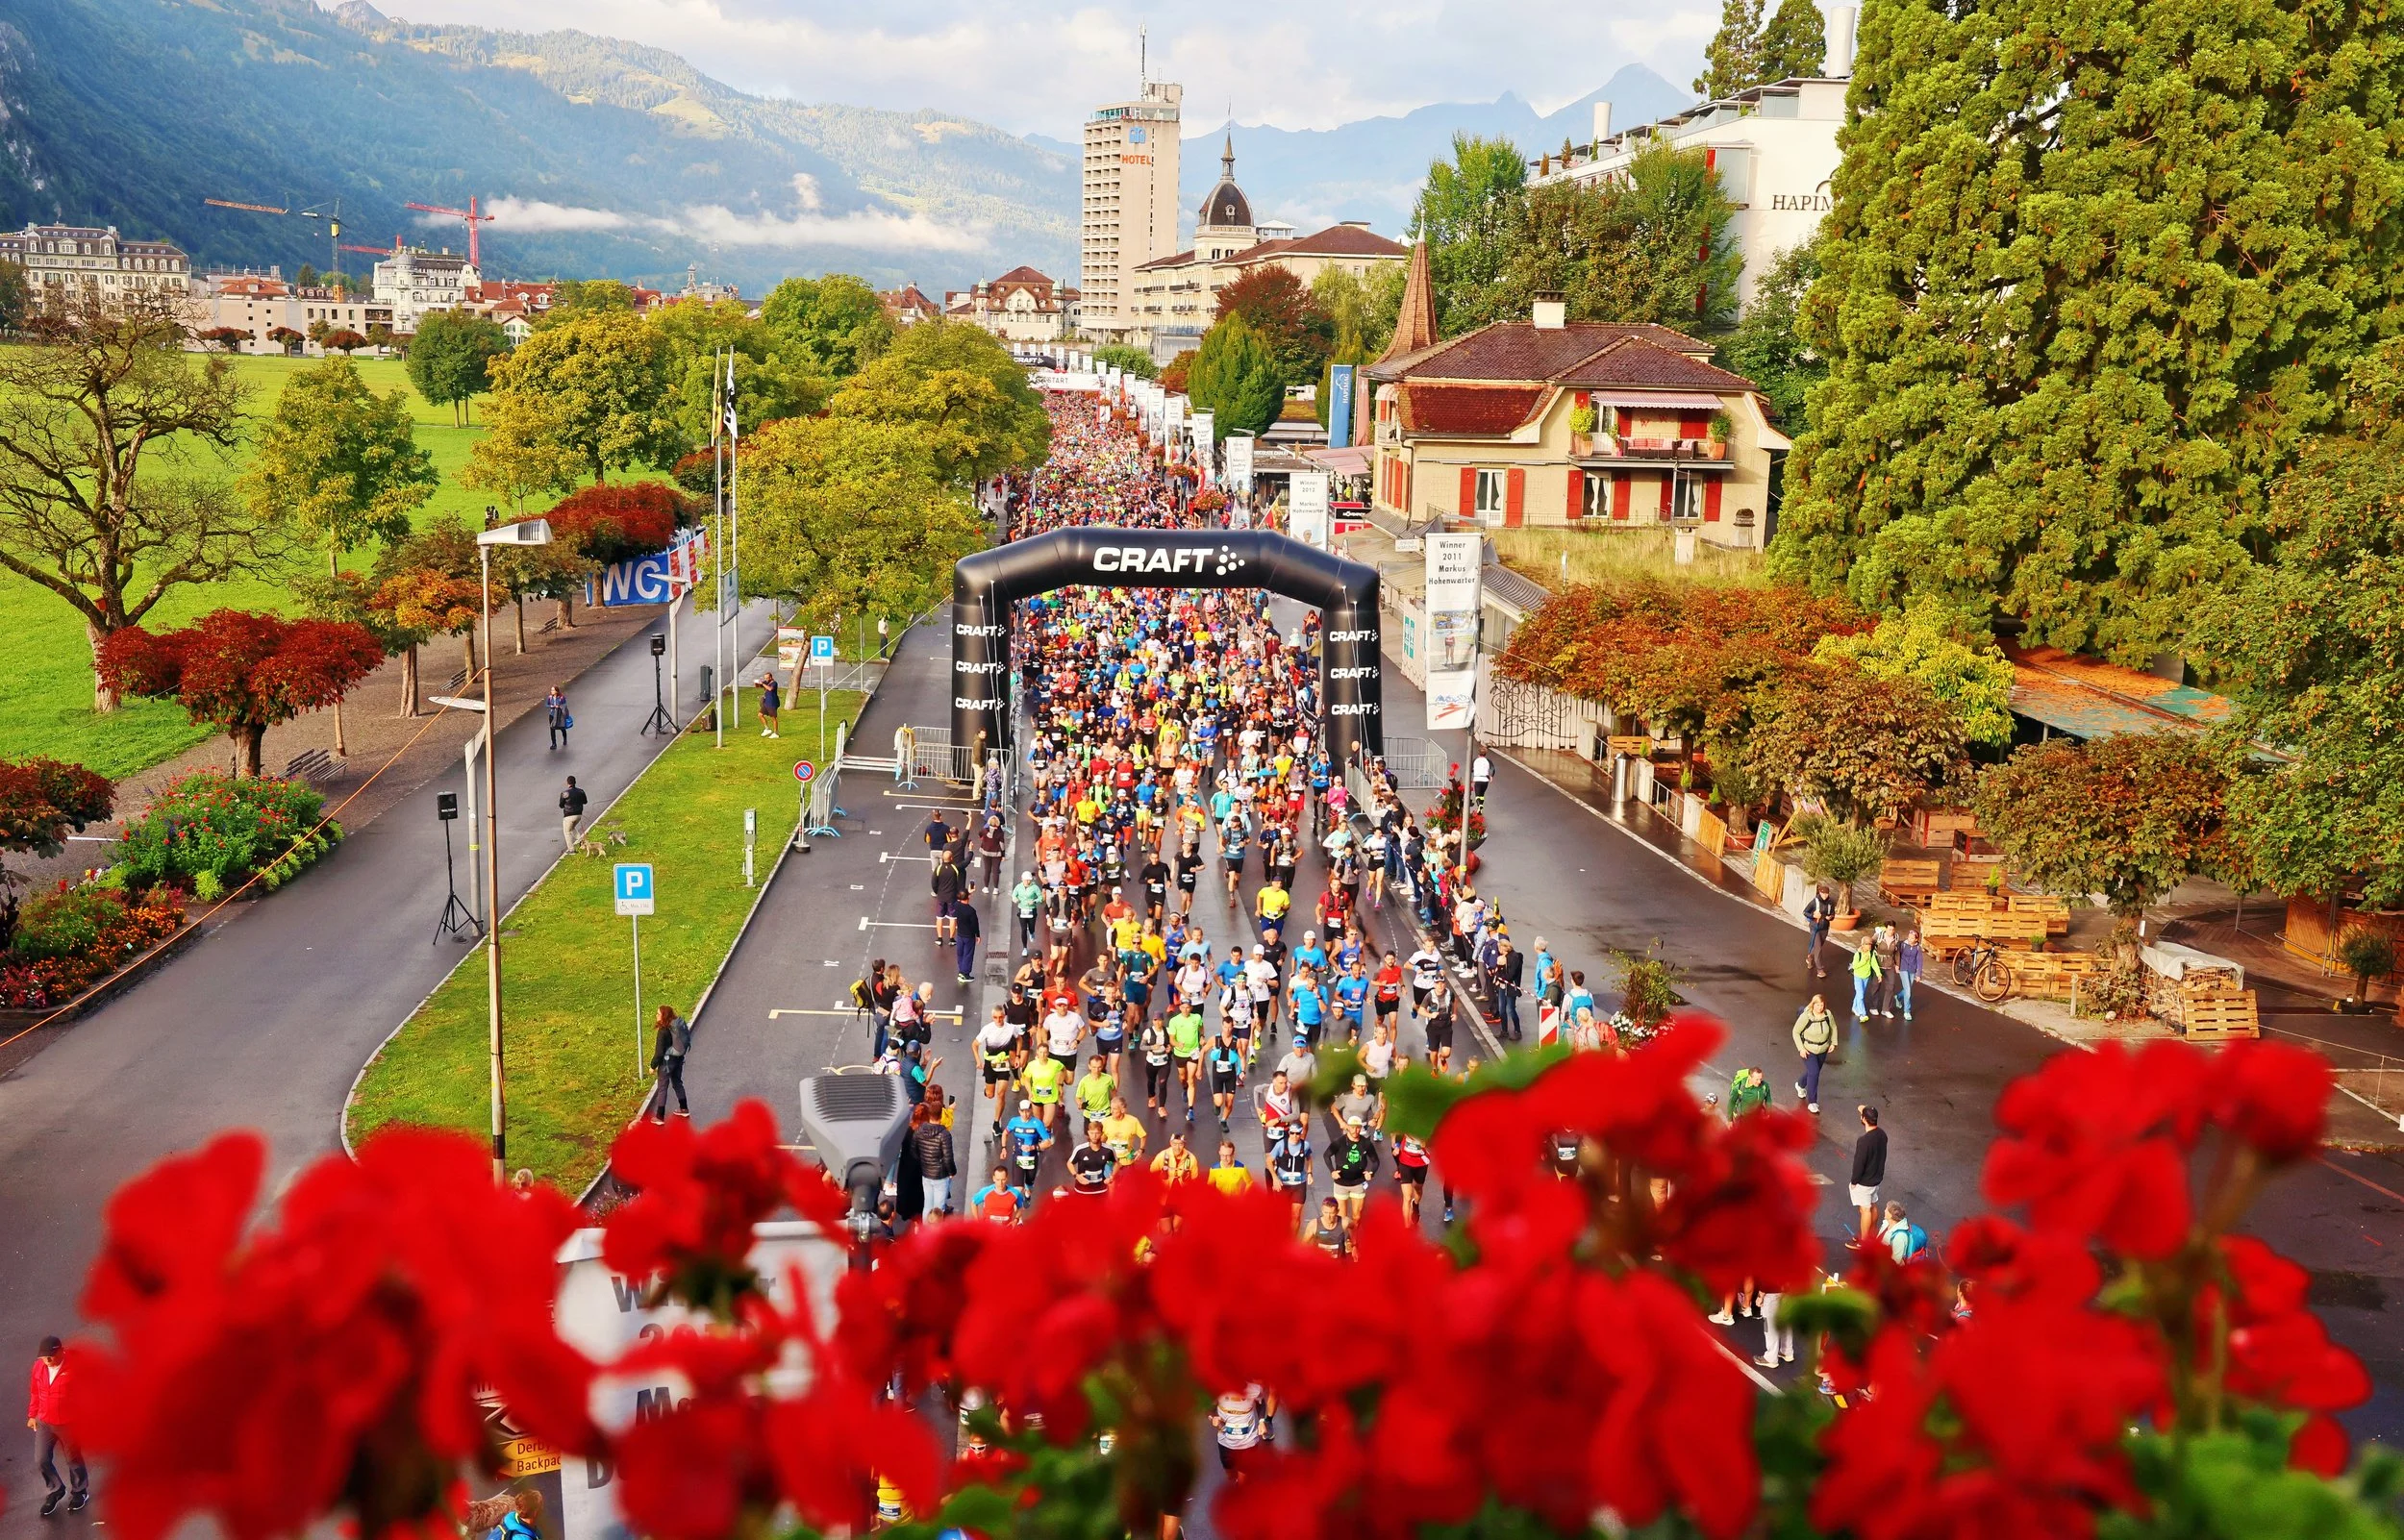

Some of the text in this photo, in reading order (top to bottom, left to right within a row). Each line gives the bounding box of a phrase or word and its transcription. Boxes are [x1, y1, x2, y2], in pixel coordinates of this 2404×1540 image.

[1121, 154, 1152, 165] HOTEL
[1439, 540, 1466, 549] Winner
[1092, 547, 1215, 573] CRAFT
[1439, 564, 1466, 573] Markus
[603, 559, 663, 601] WC
[956, 623, 998, 636] CRAFT
[1329, 631, 1371, 642] CRAFT
[817, 639, 828, 656] P
[955, 660, 997, 674] CRAFT
[1330, 667, 1372, 679] CRAFT
[955, 697, 997, 710] CRAFT
[1331, 703, 1373, 715] CRAFT
[625, 871, 643, 896] P
